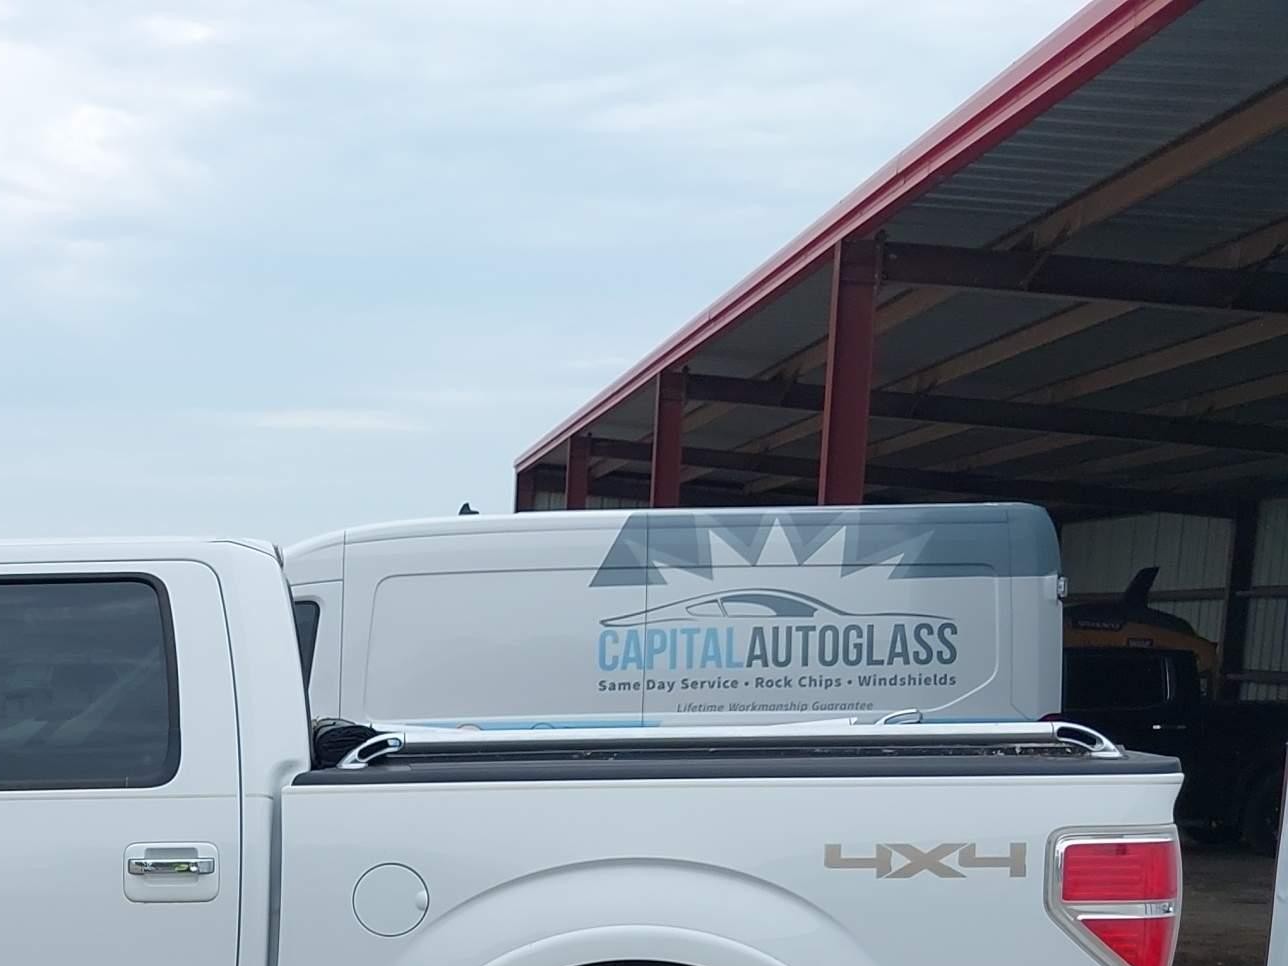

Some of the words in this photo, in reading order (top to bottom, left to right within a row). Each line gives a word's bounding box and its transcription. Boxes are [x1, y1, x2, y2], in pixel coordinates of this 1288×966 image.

[598, 679, 641, 692] Same
[646, 678, 675, 693] Day
[680, 676, 739, 690] Service
[754, 676, 793, 689] Rock
[798, 675, 842, 690] Chips
[858, 673, 957, 687] Windshields
[676, 703, 725, 713] Lifetime
[728, 701, 808, 713] Workmanship
[812, 700, 874, 711] Guarantee
